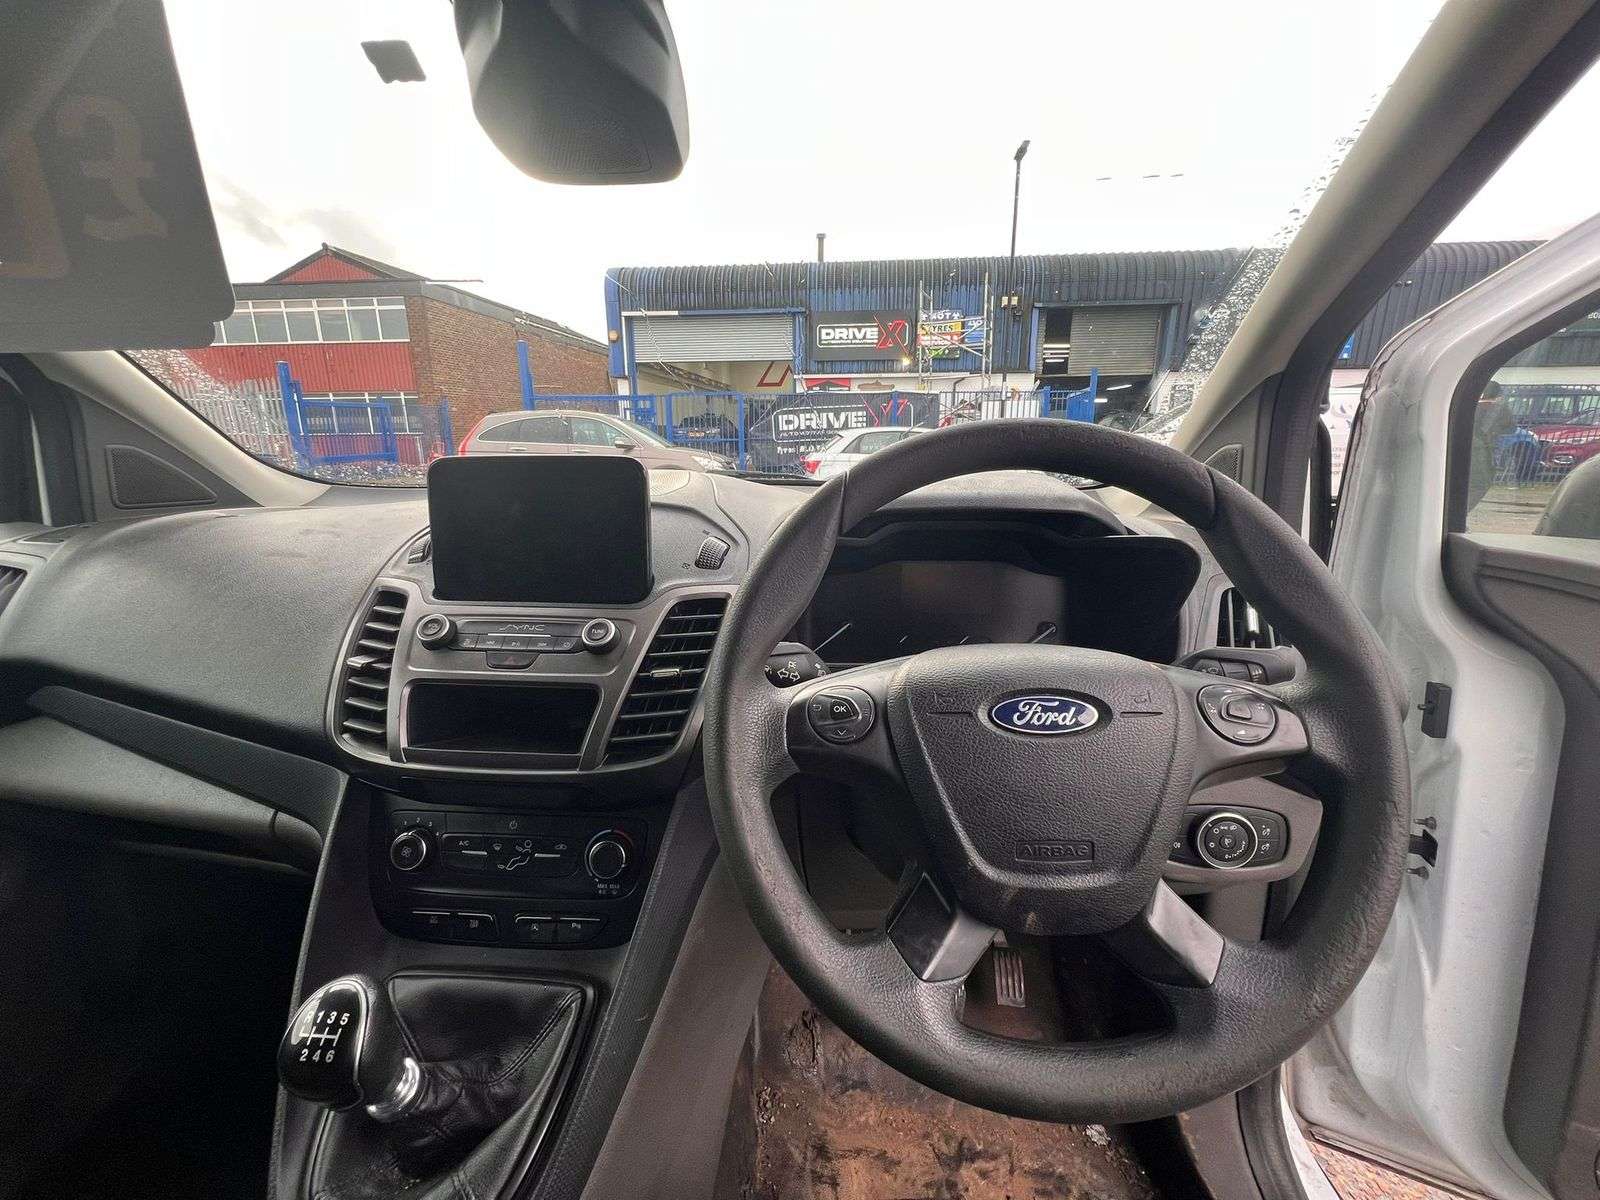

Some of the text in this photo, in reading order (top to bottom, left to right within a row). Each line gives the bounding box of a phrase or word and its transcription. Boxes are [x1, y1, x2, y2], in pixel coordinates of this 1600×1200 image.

[820, 327, 879, 340] DRIVE
[778, 410, 867, 431] DRIVE
[833, 705, 847, 713] OK
[1012, 700, 1077, 727] Ford
[1023, 844, 1090, 857] AIRBAG
[316, 1010, 325, 1023] 1
[326, 1011, 337, 1024] 3
[339, 1012, 351, 1025] 5
[299, 1048, 335, 1063] 2 4 6
